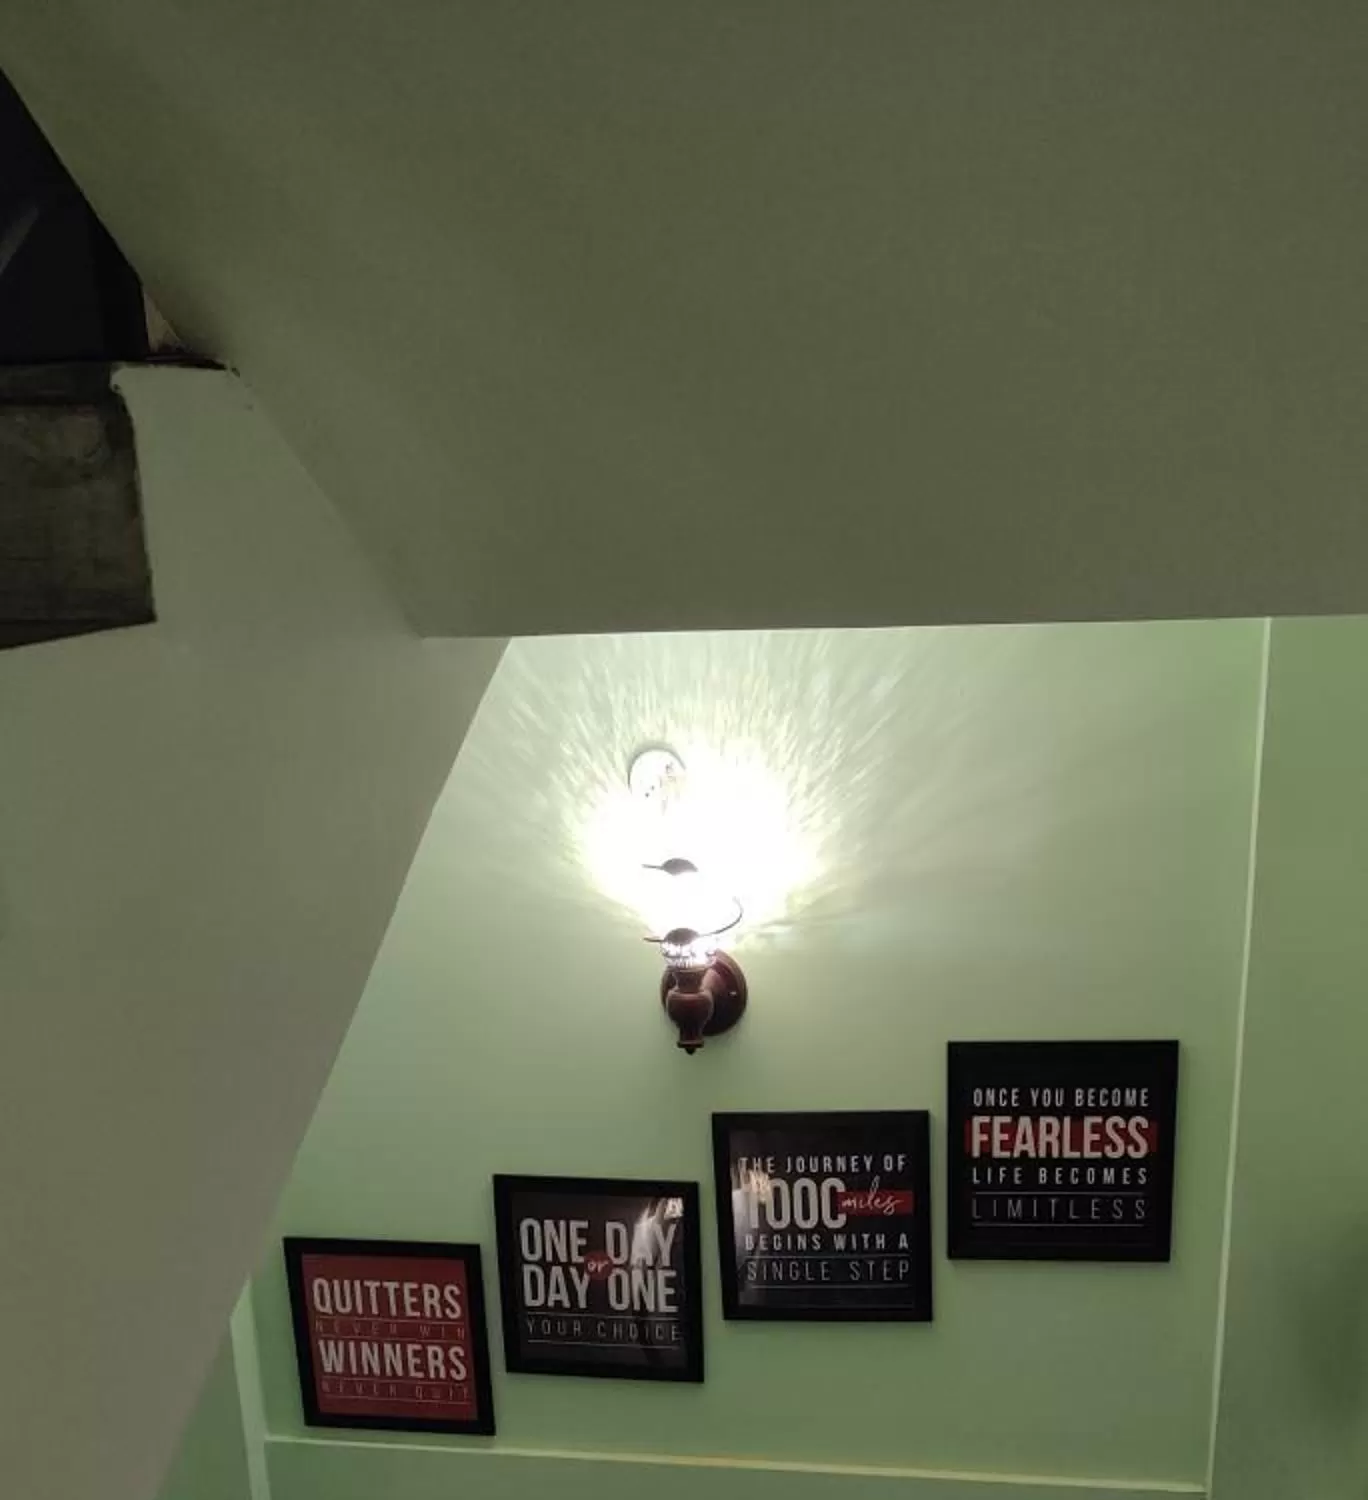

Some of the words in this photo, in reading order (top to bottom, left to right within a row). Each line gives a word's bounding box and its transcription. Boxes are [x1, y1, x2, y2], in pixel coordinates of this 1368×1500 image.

[973, 1087, 1020, 1107] ONCE
[1030, 1087, 1065, 1107] YOU
[1075, 1087, 1149, 1107] BECOME
[971, 1115, 1149, 1159] FEARLESS
[739, 1156, 775, 1173] THE
[785, 1155, 873, 1173] JOURNEY
[883, 1154, 908, 1172] OF
[972, 1167, 1023, 1185] LIFE
[1038, 1167, 1148, 1185] BECOMES
[841, 1175, 905, 1216] miles
[972, 1198, 1146, 1220] LIMITLESS
[519, 1217, 589, 1264] ONE
[605, 1220, 677, 1267] DAY
[745, 1233, 821, 1250] BEGINS
[833, 1233, 886, 1250] WITH
[898, 1232, 909, 1249] A
[587, 1261, 610, 1273] or
[747, 1261, 831, 1281] SINGLE
[850, 1260, 910, 1281] STEP
[312, 1277, 462, 1320] QUITTERS
[522, 1264, 590, 1309] DAY
[607, 1268, 679, 1313] ONE
[526, 1318, 583, 1337] YOUR
[597, 1321, 680, 1342] CHOICE
[318, 1339, 468, 1381] WINNERS
